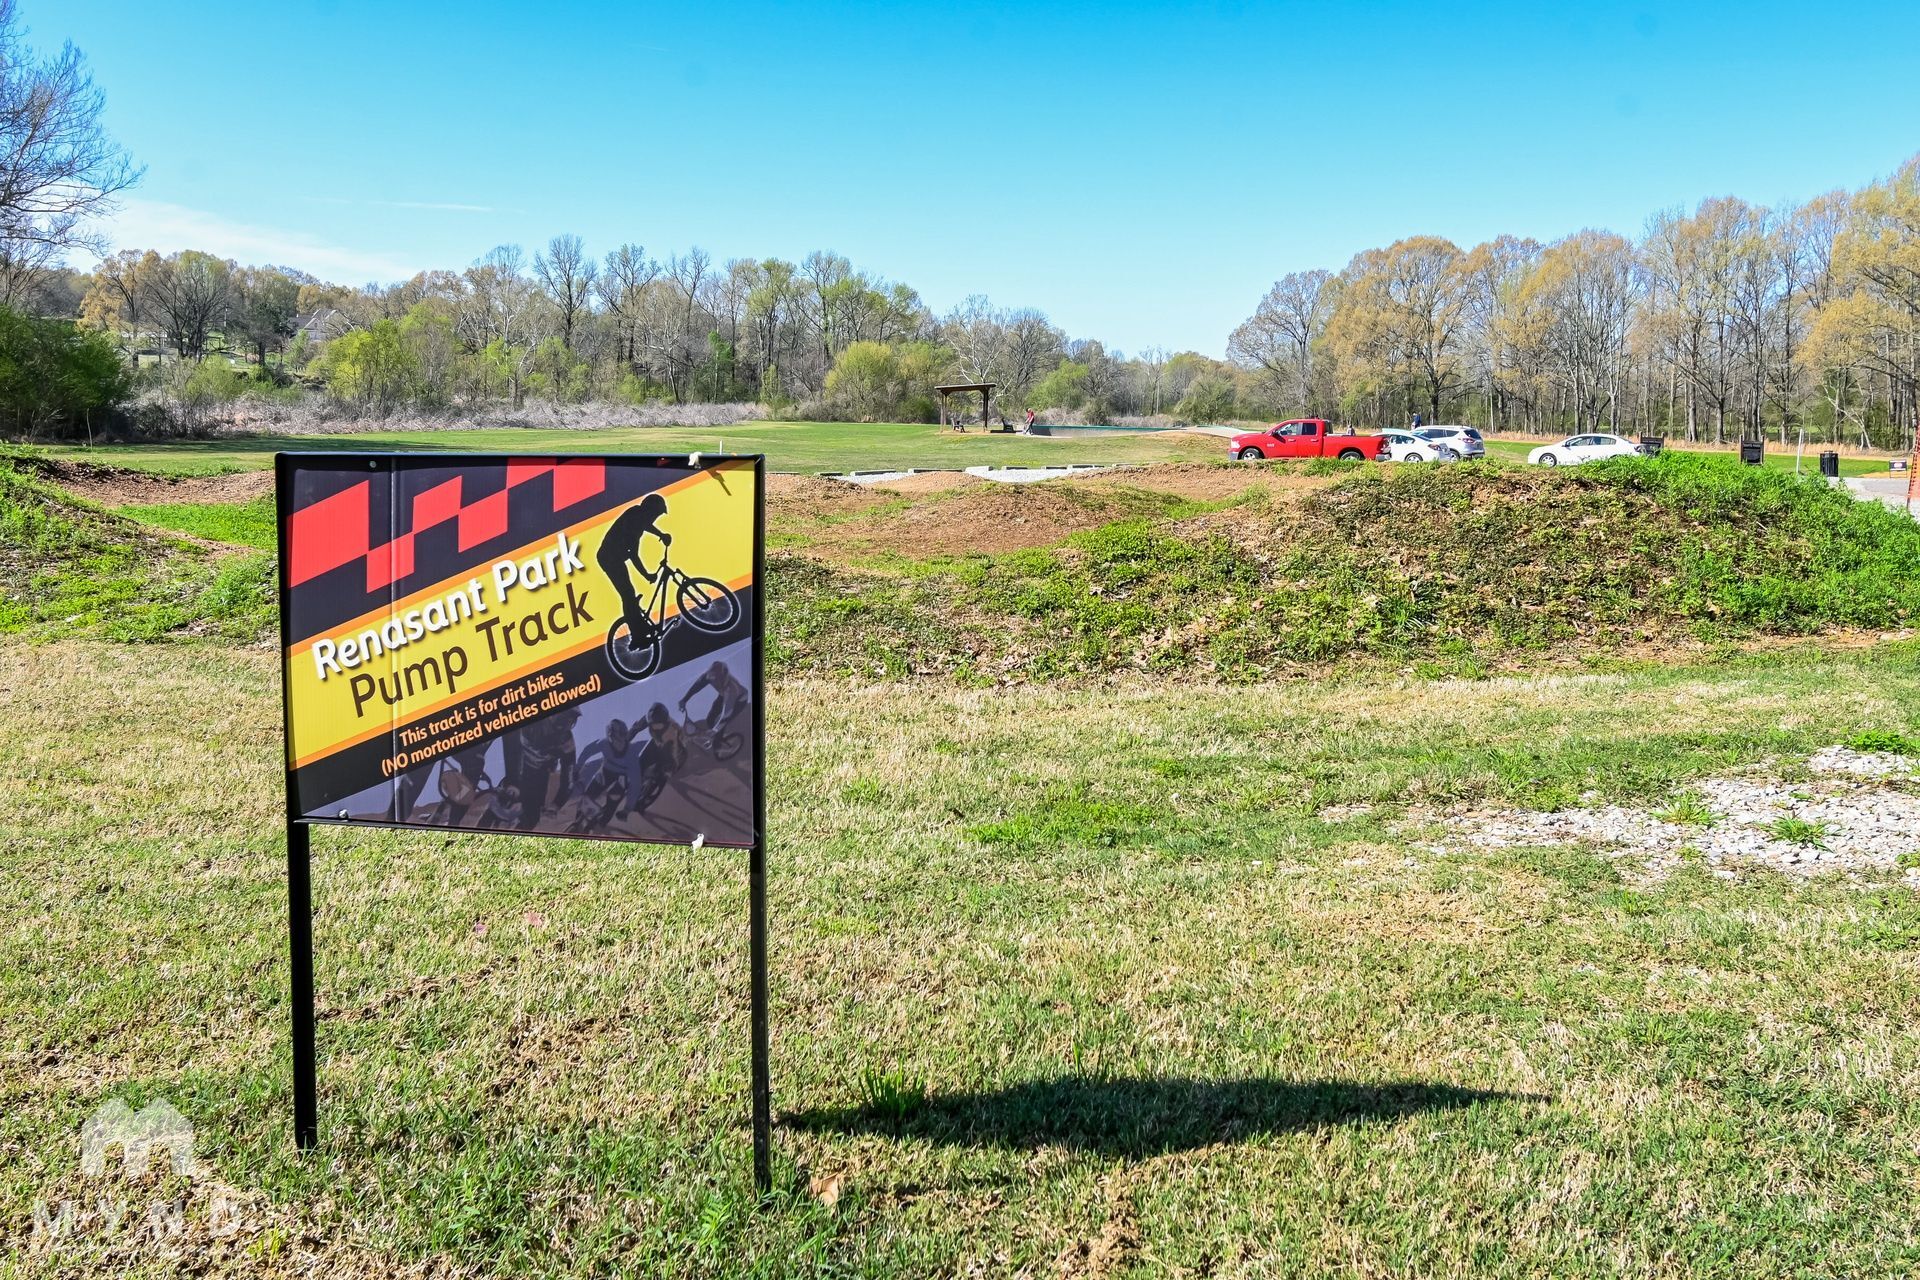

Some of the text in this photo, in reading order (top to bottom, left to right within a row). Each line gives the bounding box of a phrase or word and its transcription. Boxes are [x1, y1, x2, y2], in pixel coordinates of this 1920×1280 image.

[312, 532, 585, 680] Renasant Park
[350, 582, 594, 717] Pump Track
[381, 673, 602, 777] (NO mortorized vehicles allowed)
[399, 672, 565, 747] This track is for dirt bikes
